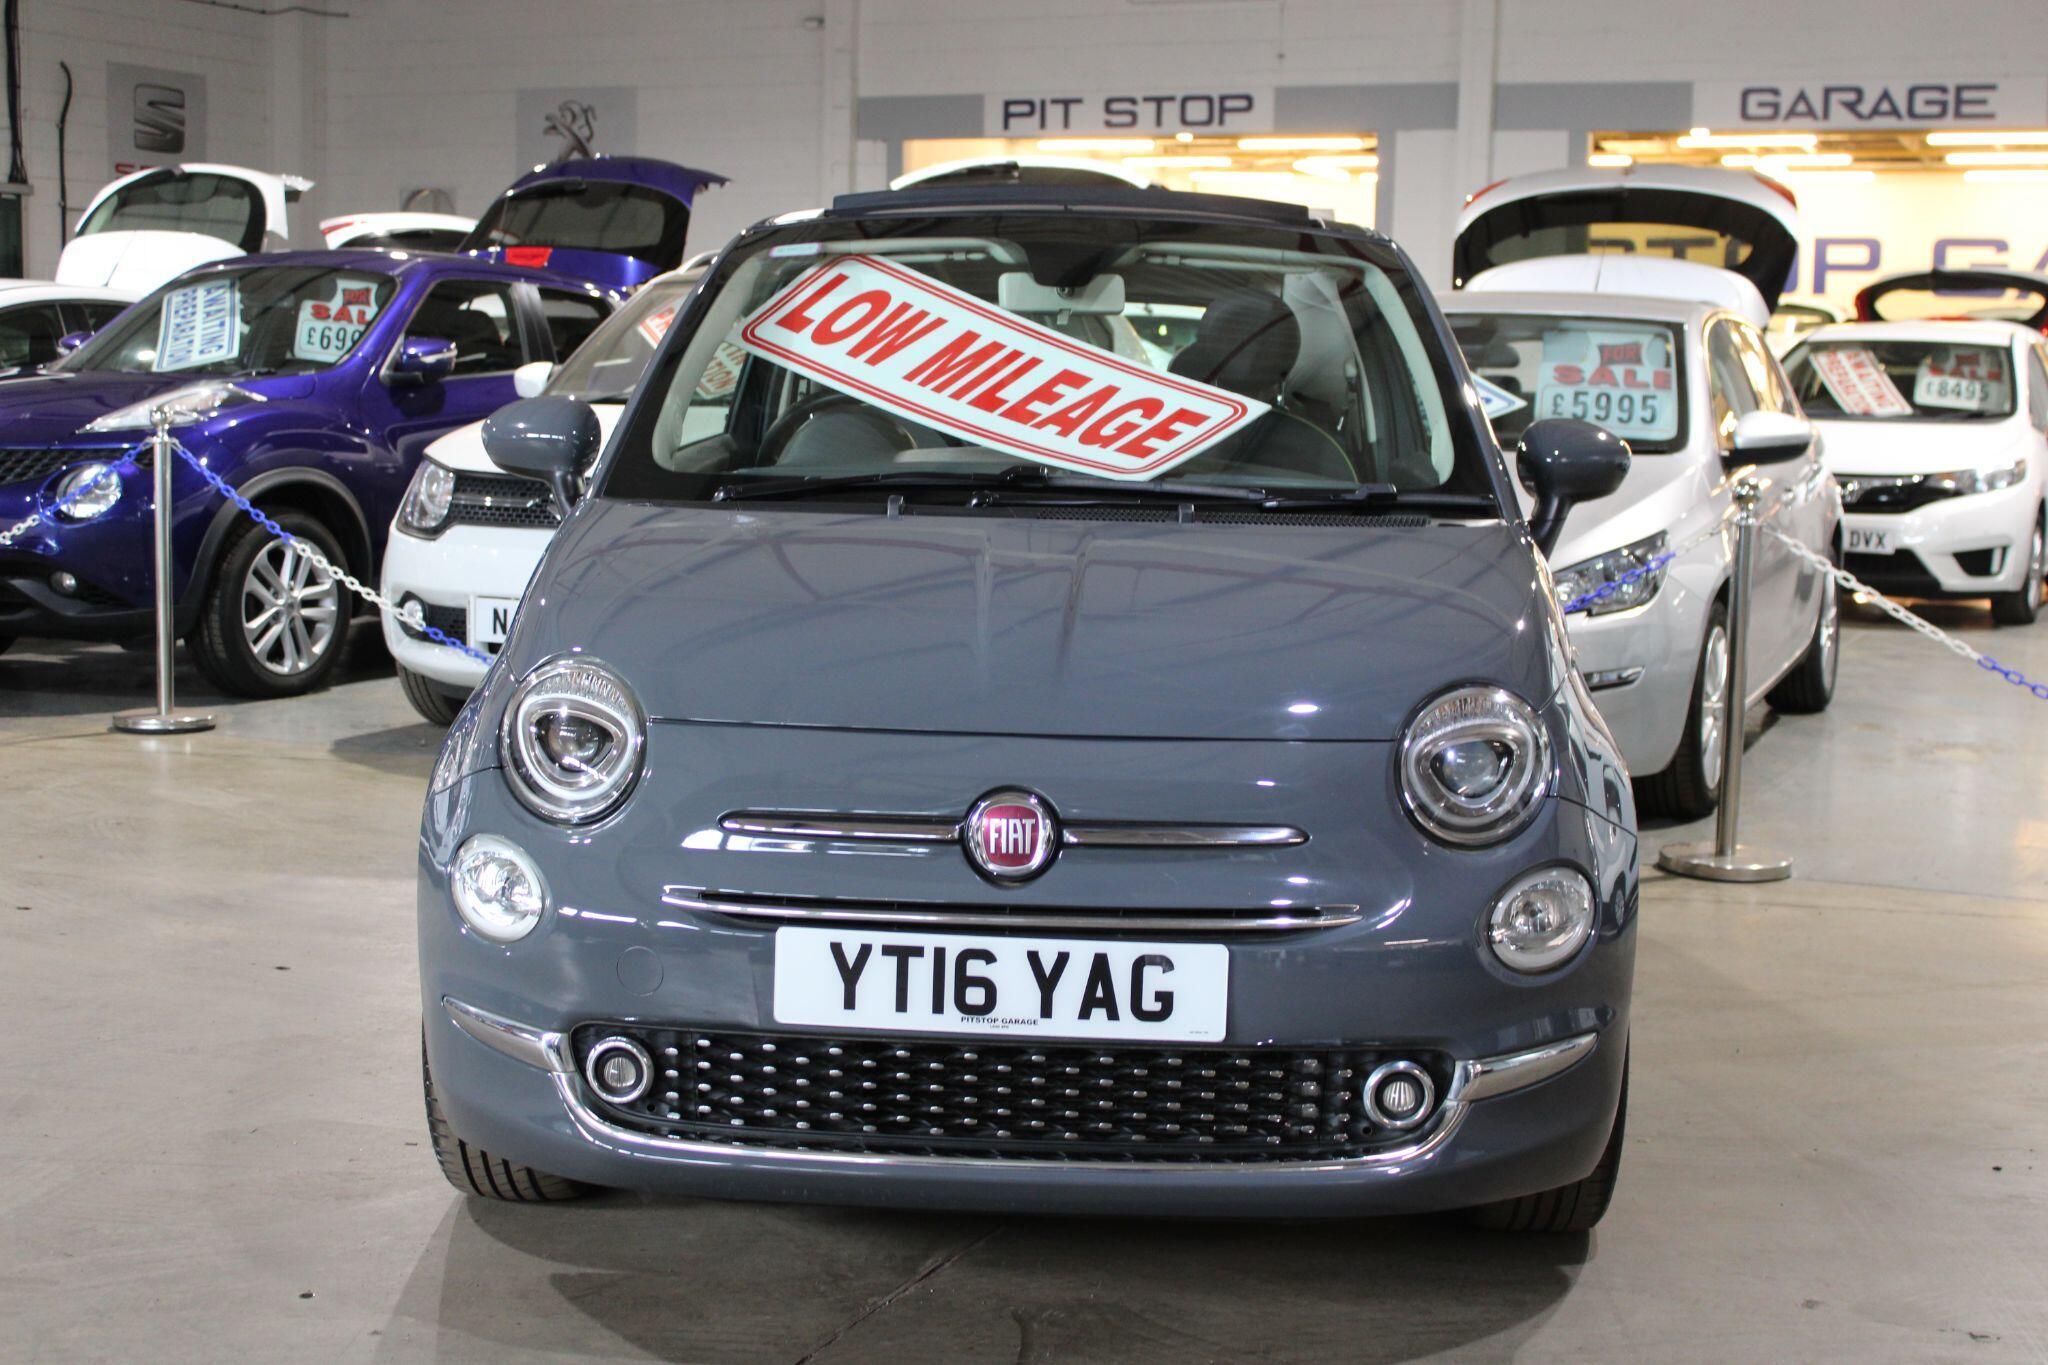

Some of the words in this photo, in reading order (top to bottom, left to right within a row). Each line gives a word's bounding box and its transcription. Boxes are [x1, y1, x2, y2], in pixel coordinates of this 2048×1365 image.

[1003, 99, 1083, 130] PIT
[1103, 94, 1254, 128] STOP
[1740, 84, 1998, 121] GARAGE
[311, 303, 369, 325] SAL
[776, 273, 947, 367] LOW
[902, 330, 1211, 460] MILEAGE
[1553, 364, 1673, 390] SALE
[1552, 390, 1659, 425] £5995
[1850, 530, 1887, 549] DVX
[989, 818, 1036, 855] FIAT
[829, 941, 998, 1017] YT16
[1026, 949, 1175, 1023] YAG
[960, 1016, 999, 1025] PITSTOP
[1001, 1017, 1039, 1026] GARAGE
